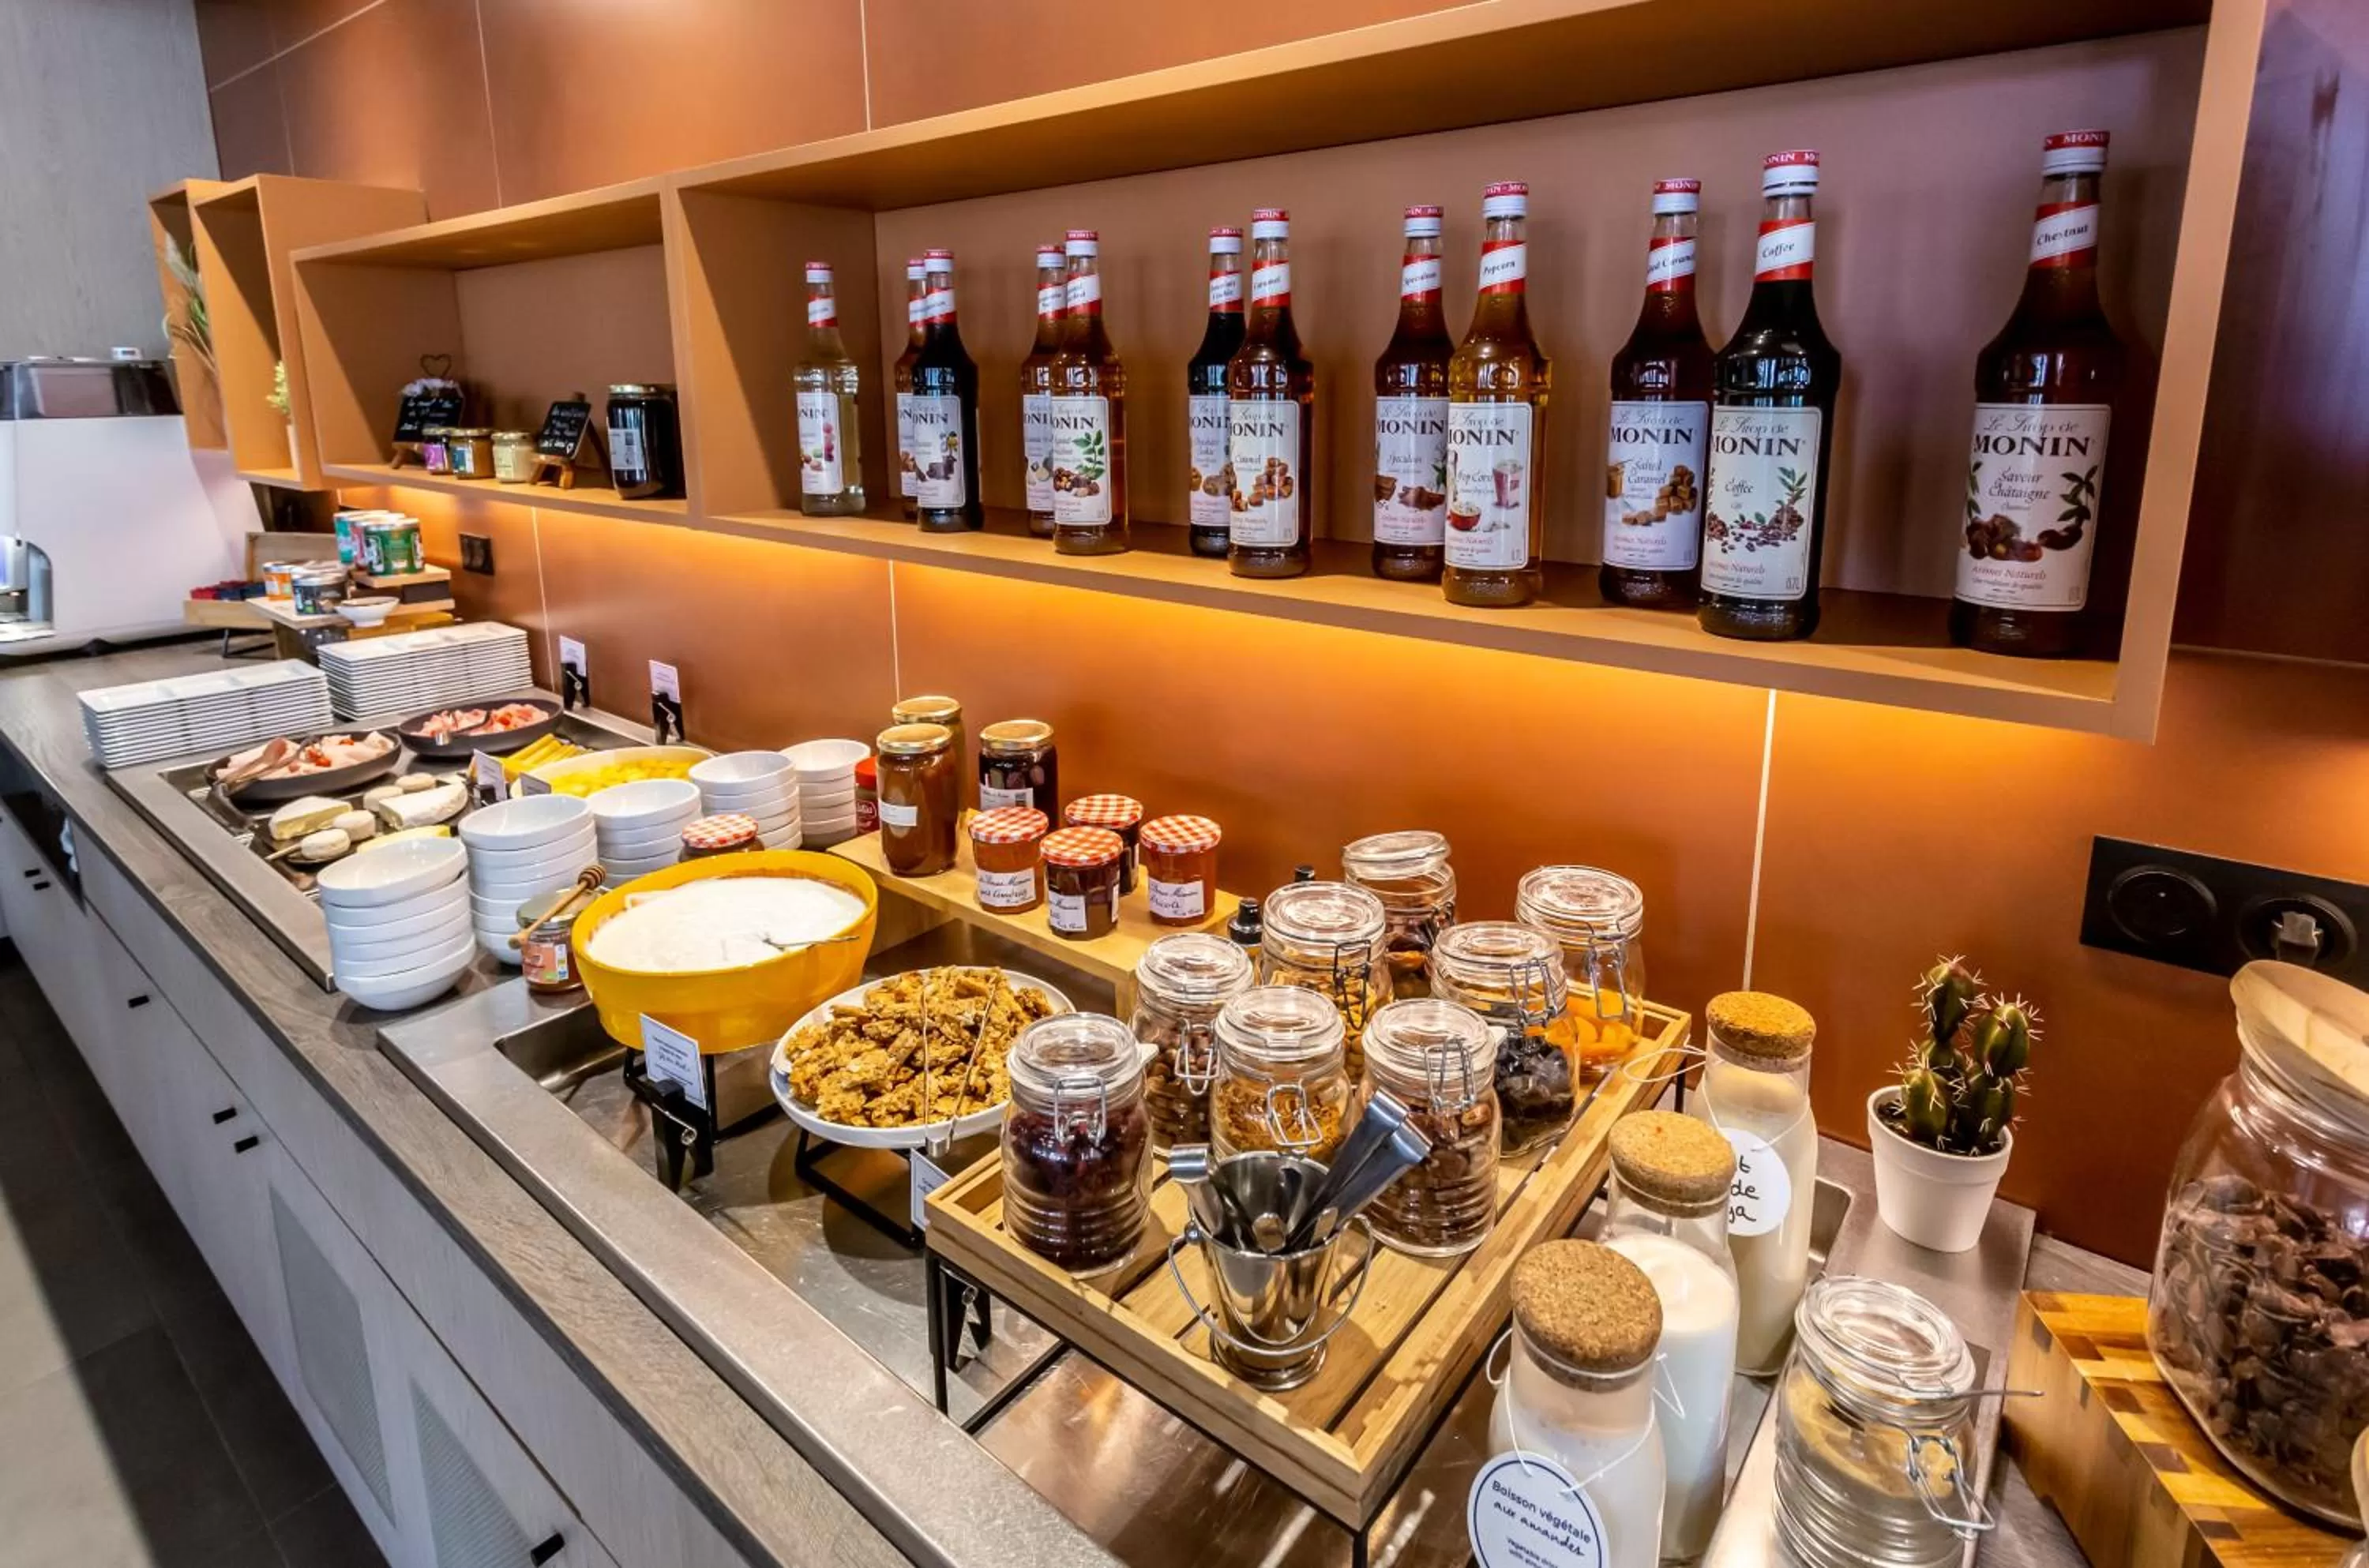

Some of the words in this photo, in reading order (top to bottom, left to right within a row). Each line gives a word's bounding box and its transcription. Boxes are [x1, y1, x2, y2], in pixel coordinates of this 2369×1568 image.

[1052, 416, 1095, 430] ONIN
[1230, 422, 1285, 437] ONIN
[1450, 429, 1515, 446] ONIN
[1974, 434, 2090, 456] MONIN
[1730, 1179, 1760, 1200] de
[1491, 1480, 1536, 1514] Boisson
[1539, 1507, 1591, 1544] végétale
[1492, 1501, 1516, 1519] aux
[1520, 1517, 1586, 1556] amandes
